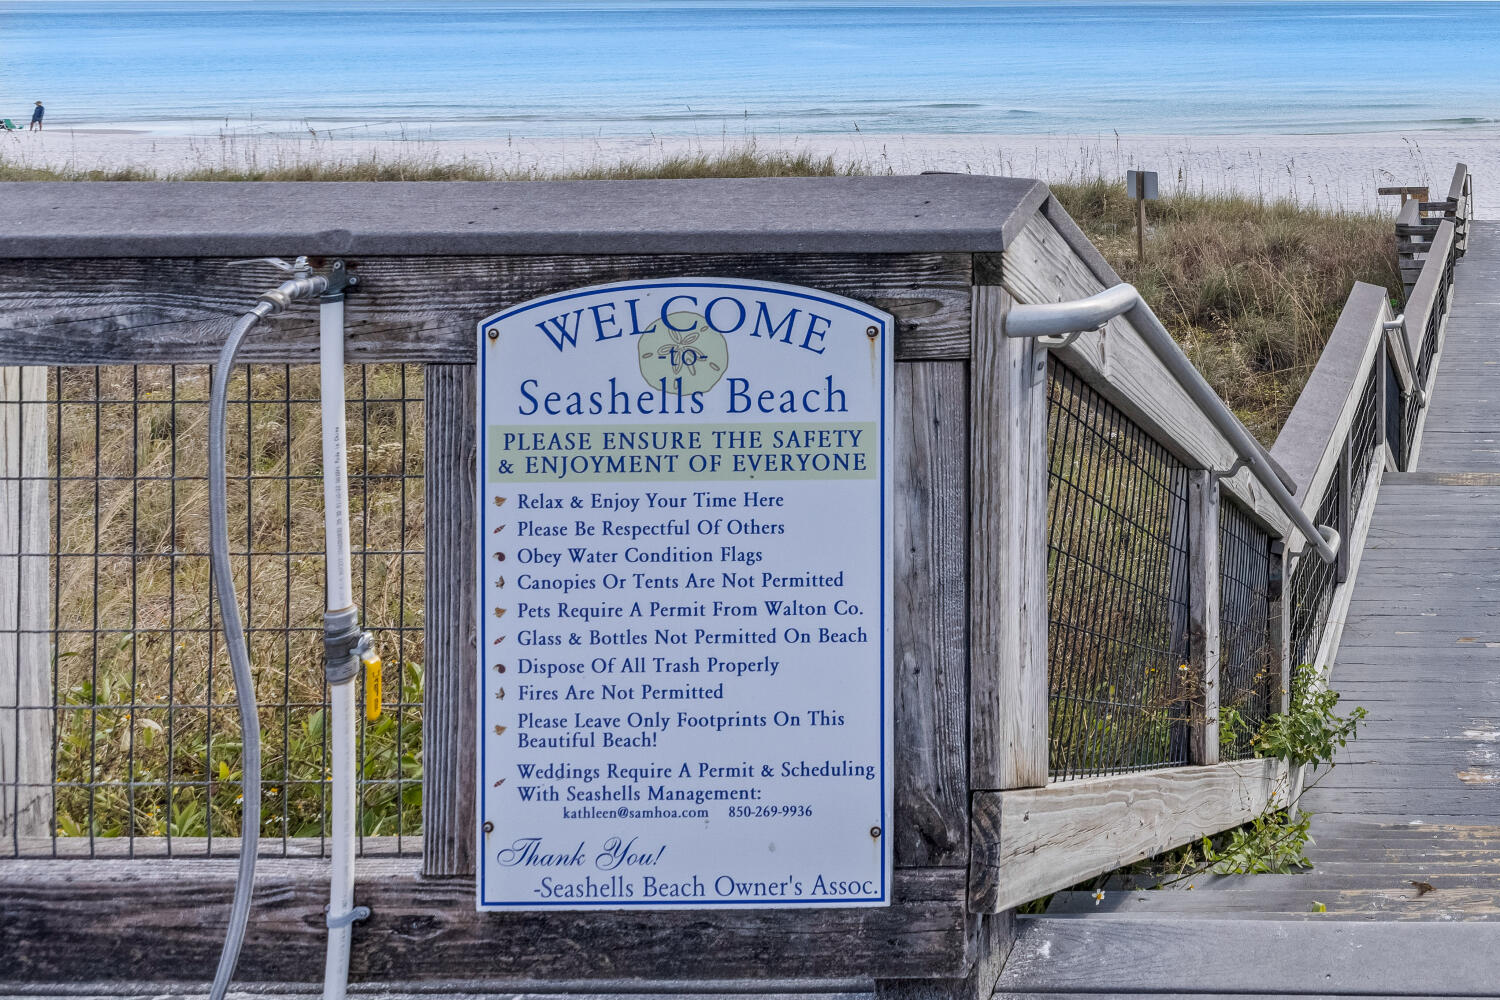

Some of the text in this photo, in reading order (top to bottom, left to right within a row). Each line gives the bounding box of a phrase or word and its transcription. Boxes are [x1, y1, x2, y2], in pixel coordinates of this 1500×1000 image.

[535, 295, 832, 355] WELCOME
[518, 374, 849, 416] Seashells Beach
[503, 429, 863, 451] PLEASE ENSURE THE SAFETY
[498, 452, 867, 479] & ENJOYMENT OF EVERYONE
[518, 491, 784, 513] Relax & Enjoy Your Time Here
[517, 518, 785, 541] Please Be Respectful Of Others
[517, 545, 763, 568] Obey Water Condition Flags
[517, 570, 844, 594] Canopies Or Tents Are Not Permitted
[517, 599, 864, 623] Pets Require A Permit From Walton Co.
[517, 626, 868, 646] Glass & Bottles Not Permitted On Beach
[517, 655, 780, 679] Dispose Of All Trash Properly
[518, 682, 724, 701] Fires Are Not Permitted
[518, 709, 845, 732] Please Leave Only Footprints On This
[518, 731, 657, 748] Beautiful Beach!
[516, 760, 876, 784] Weddings Require A Permit & Scheduling
[517, 784, 761, 805] With Seashells Management:
[563, 805, 813, 819] kathleen@samhoa.com 850-269-9936
[496, 836, 667, 871] Thank You!
[642, 874, 706, 897] Beach
[714, 874, 803, 897] Owner's
[810, 874, 878, 896] Assoc.
